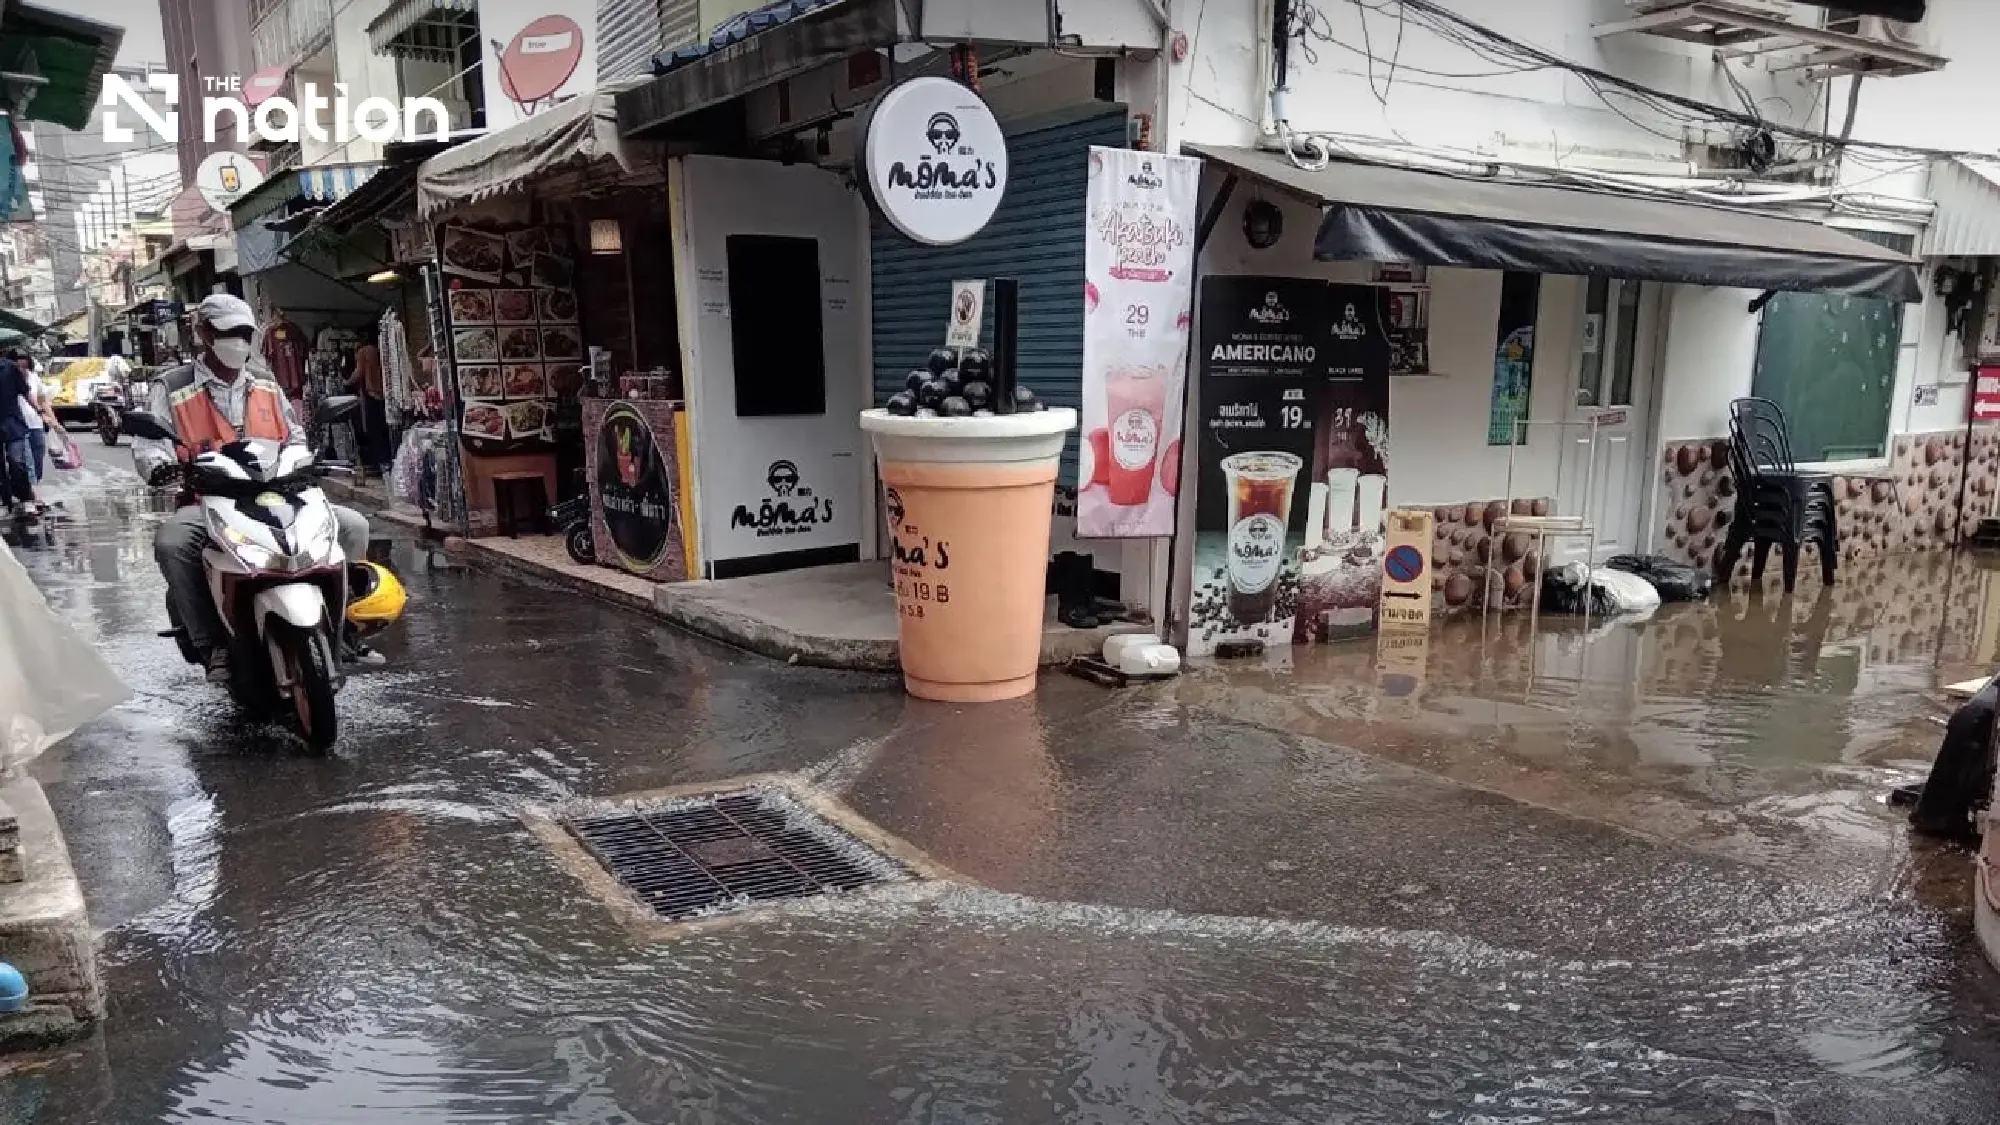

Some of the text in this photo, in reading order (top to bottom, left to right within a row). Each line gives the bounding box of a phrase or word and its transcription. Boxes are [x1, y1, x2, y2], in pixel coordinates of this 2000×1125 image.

[1125, 304, 1149, 324] 29
[1211, 343, 1316, 363] AMERICANO
[1280, 405, 1303, 429] 19
